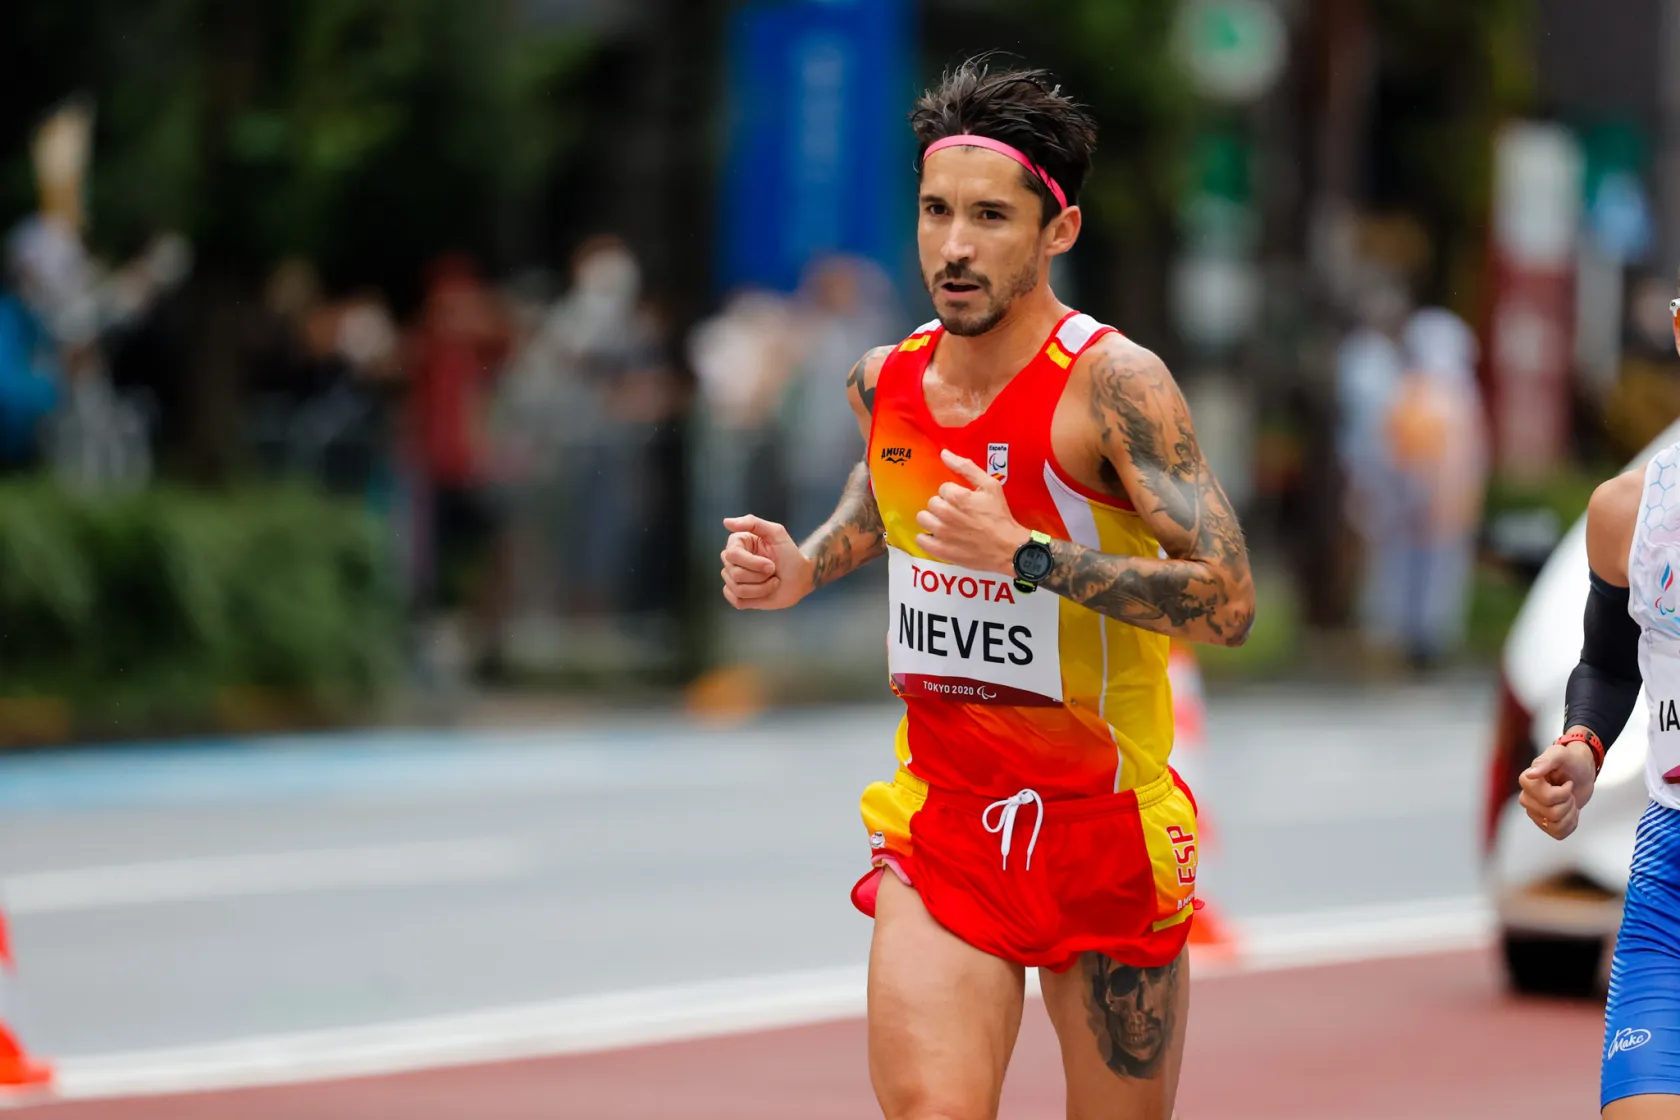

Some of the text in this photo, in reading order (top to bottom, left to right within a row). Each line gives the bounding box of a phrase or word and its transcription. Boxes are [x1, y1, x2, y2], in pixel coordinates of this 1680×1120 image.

[881, 448, 912, 459] AMURA
[911, 564, 1015, 605] TOYOTA
[899, 602, 1033, 666] NIEVES
[923, 680, 974, 696] TOKYO 2020
[1659, 699, 1680, 732] IA
[1165, 825, 1196, 885] ESP
